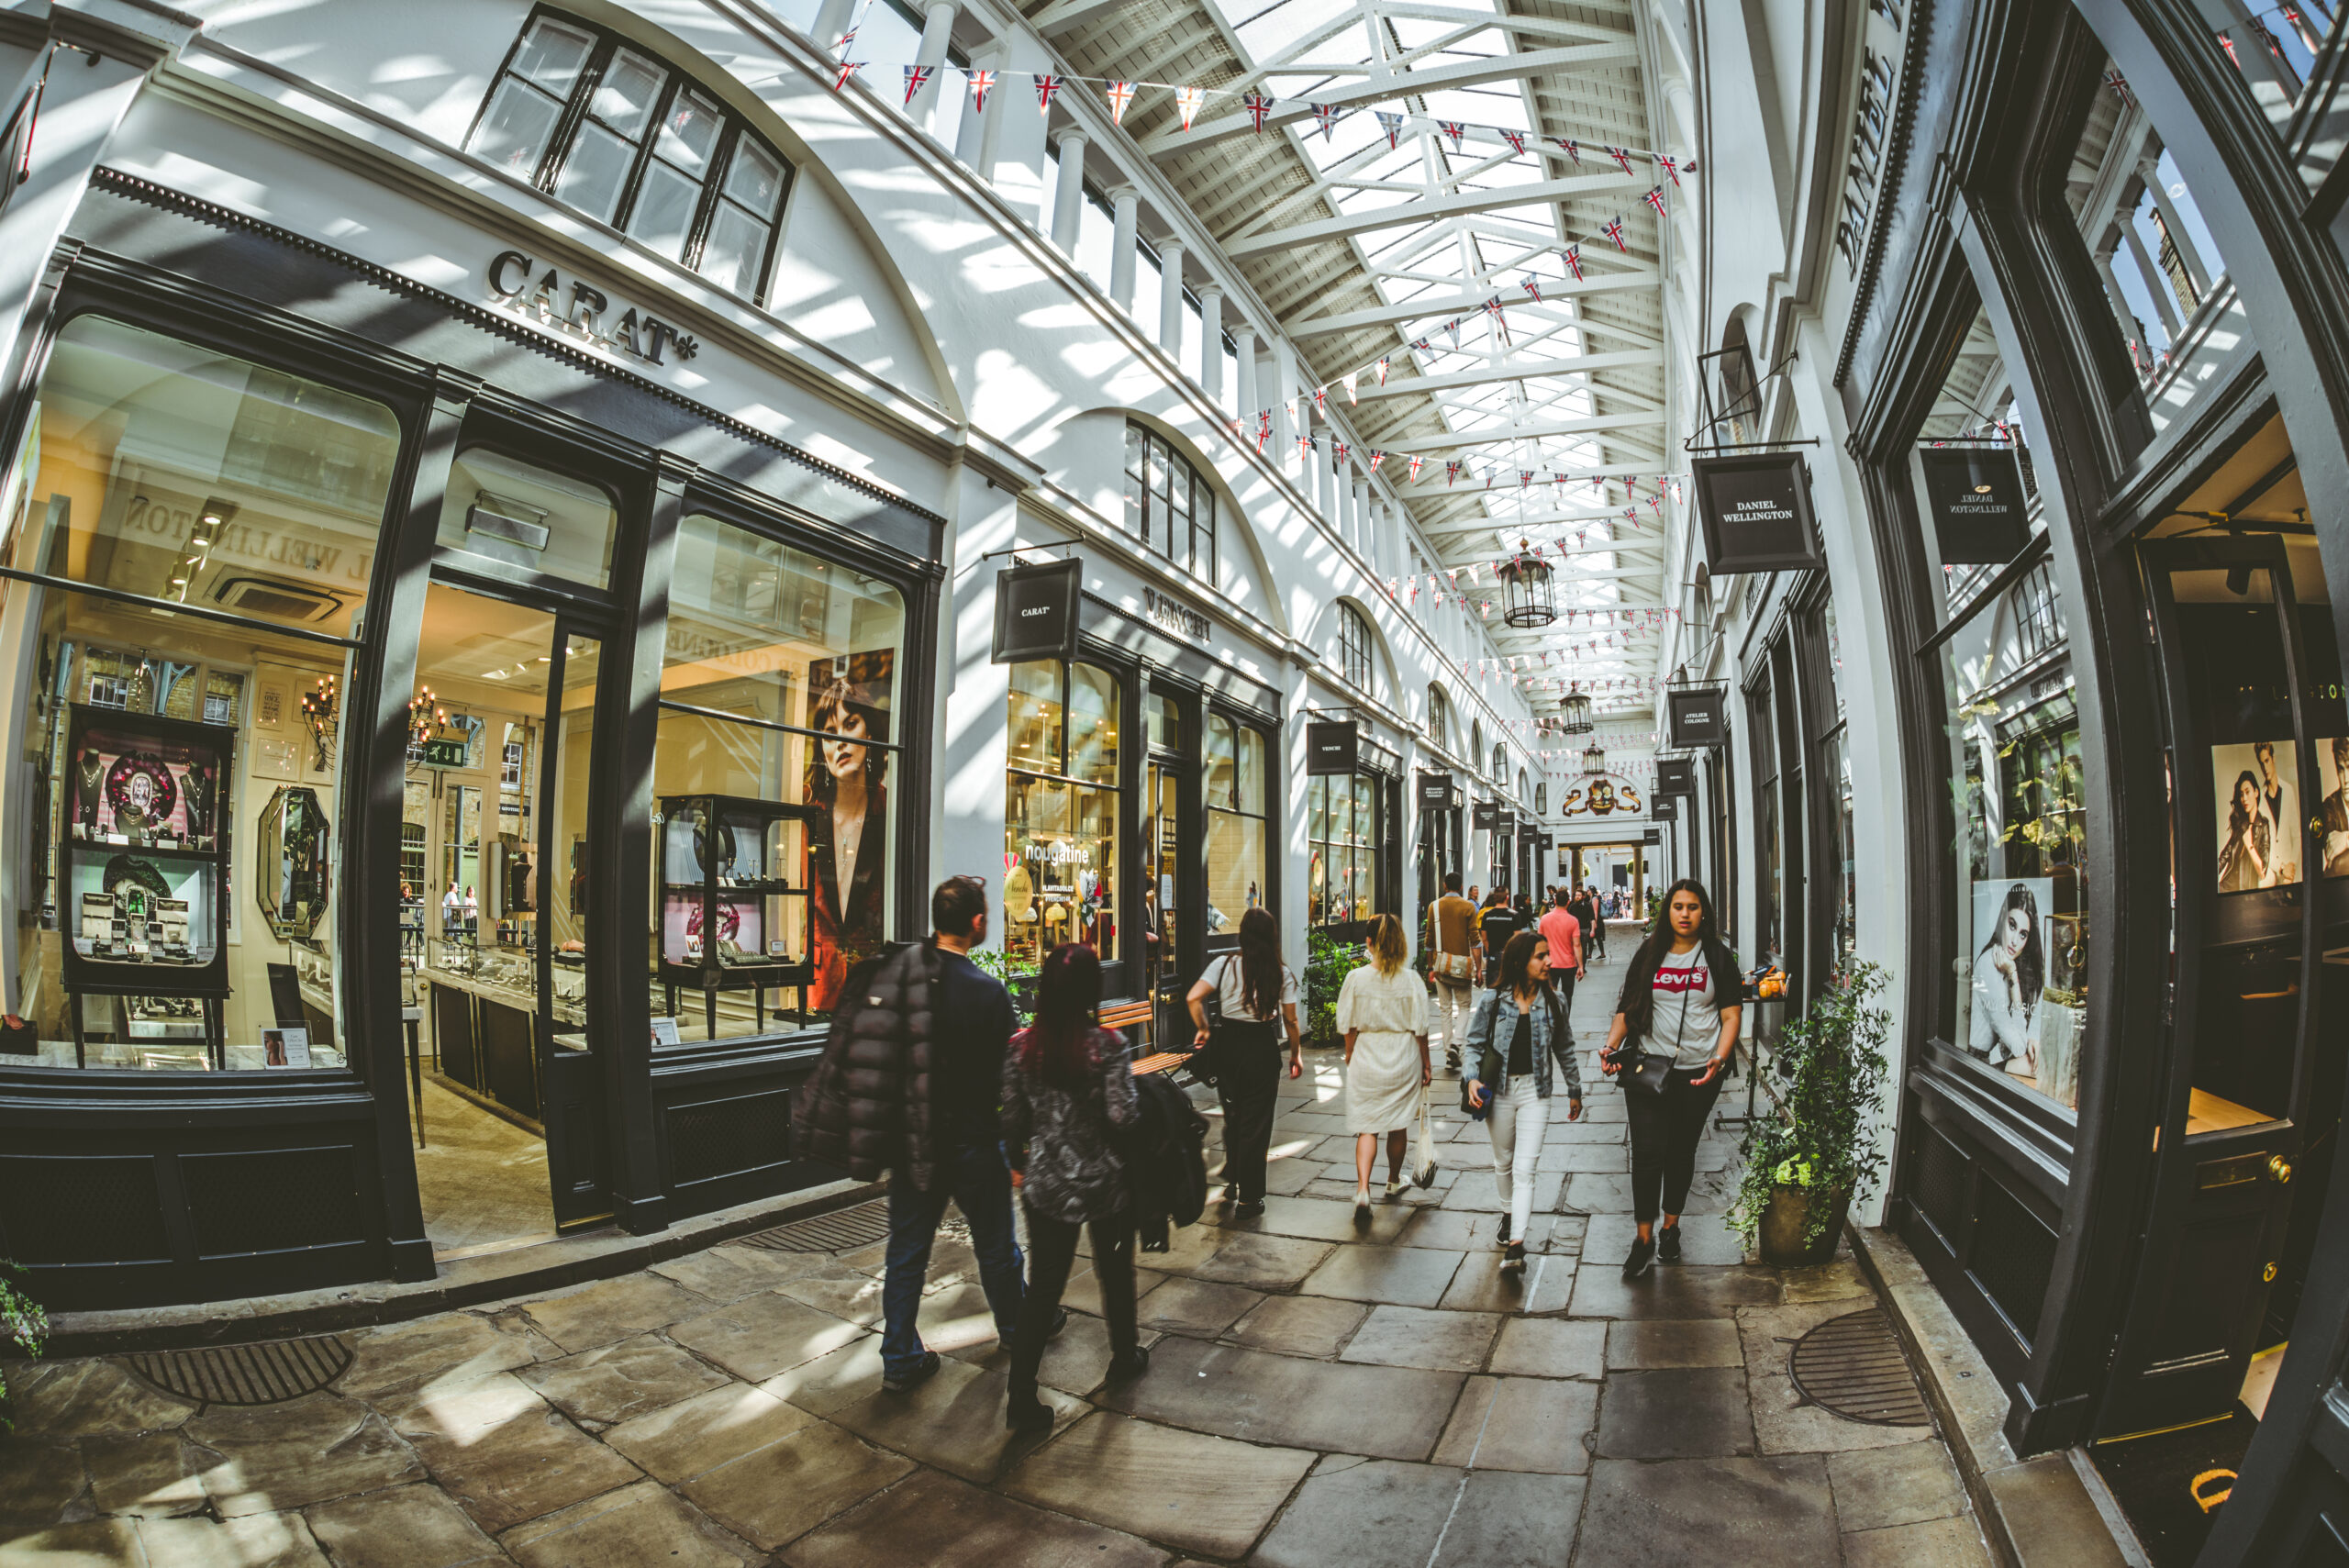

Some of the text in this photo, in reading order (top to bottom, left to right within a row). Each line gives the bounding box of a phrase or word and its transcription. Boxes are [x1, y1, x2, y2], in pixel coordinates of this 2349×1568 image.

[1736, 500, 1777, 511] DANIEL
[1723, 509, 1794, 524] WELLINGTON
[1144, 585, 1212, 643] VENCHI
[1025, 844, 1089, 867] nougatine
